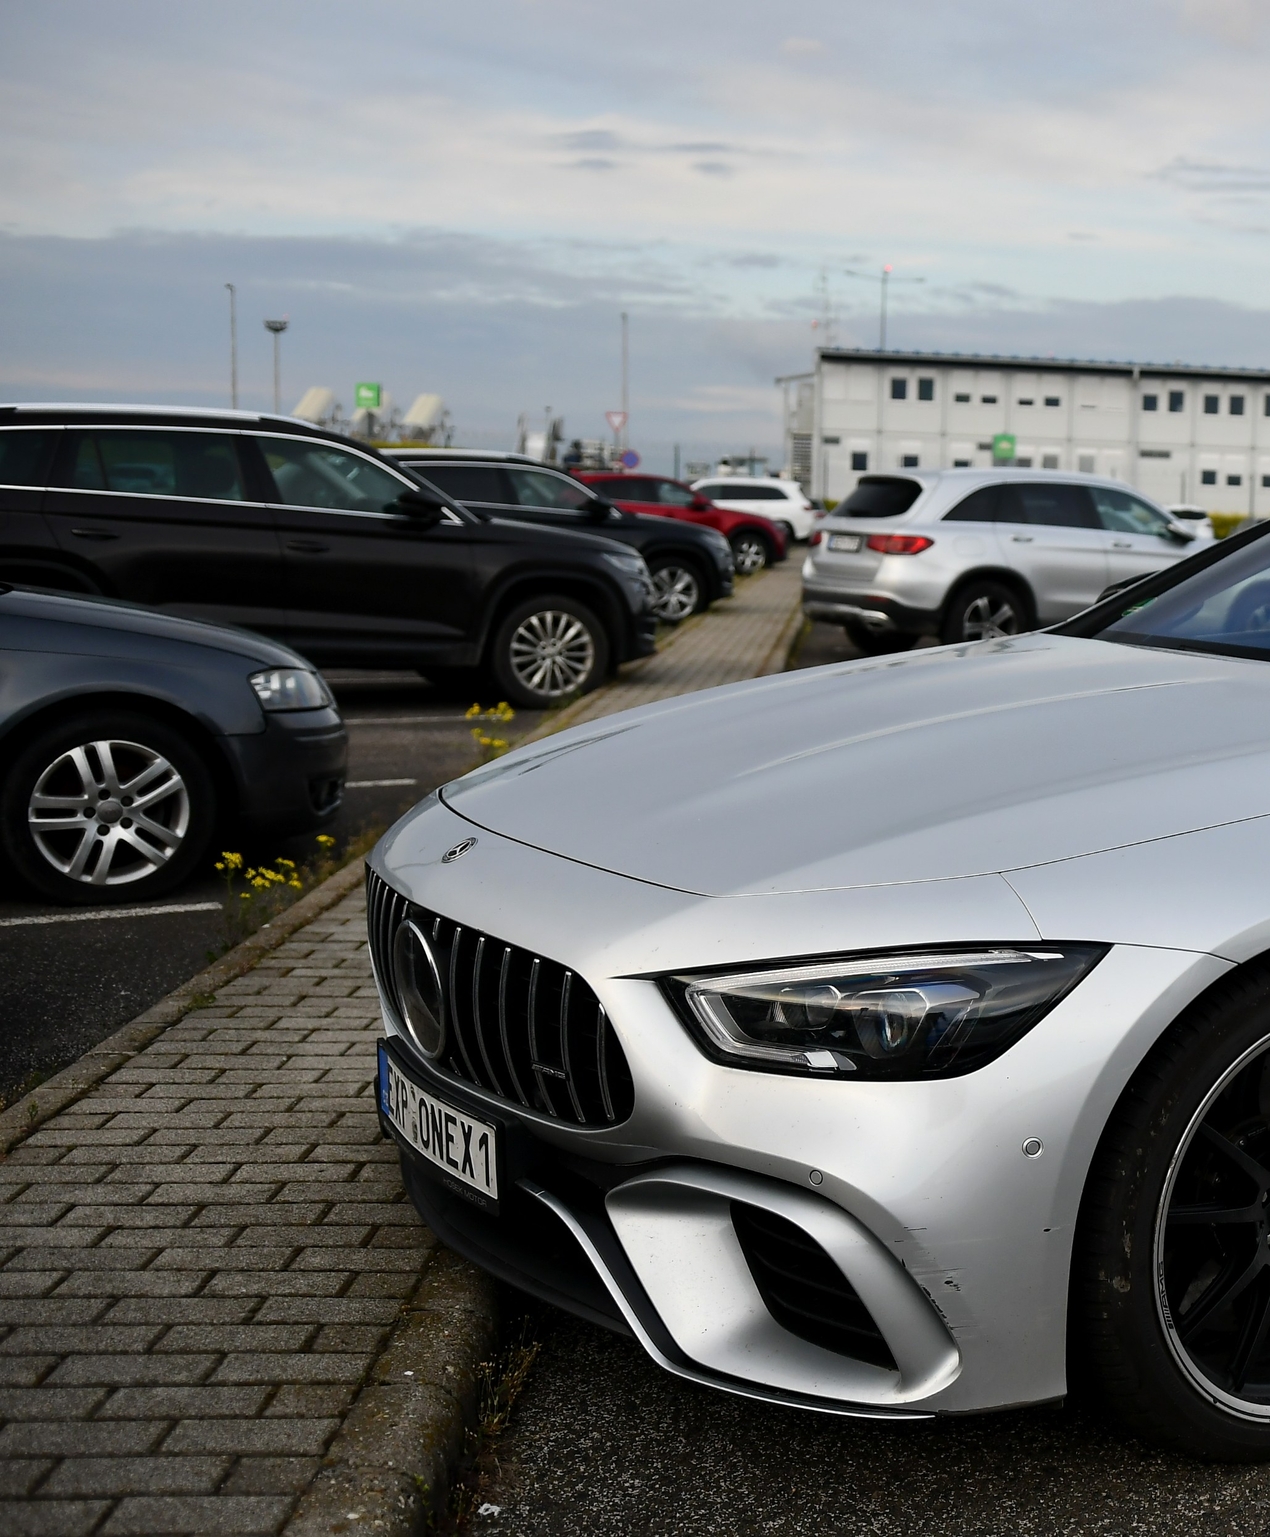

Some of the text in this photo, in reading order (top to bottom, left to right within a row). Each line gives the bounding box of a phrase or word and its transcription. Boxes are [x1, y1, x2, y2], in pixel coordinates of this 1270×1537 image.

[388, 1062, 408, 1131] EXP
[418, 1097, 490, 1188] ONEX1
[464, 1190, 487, 1207] MOTOR
